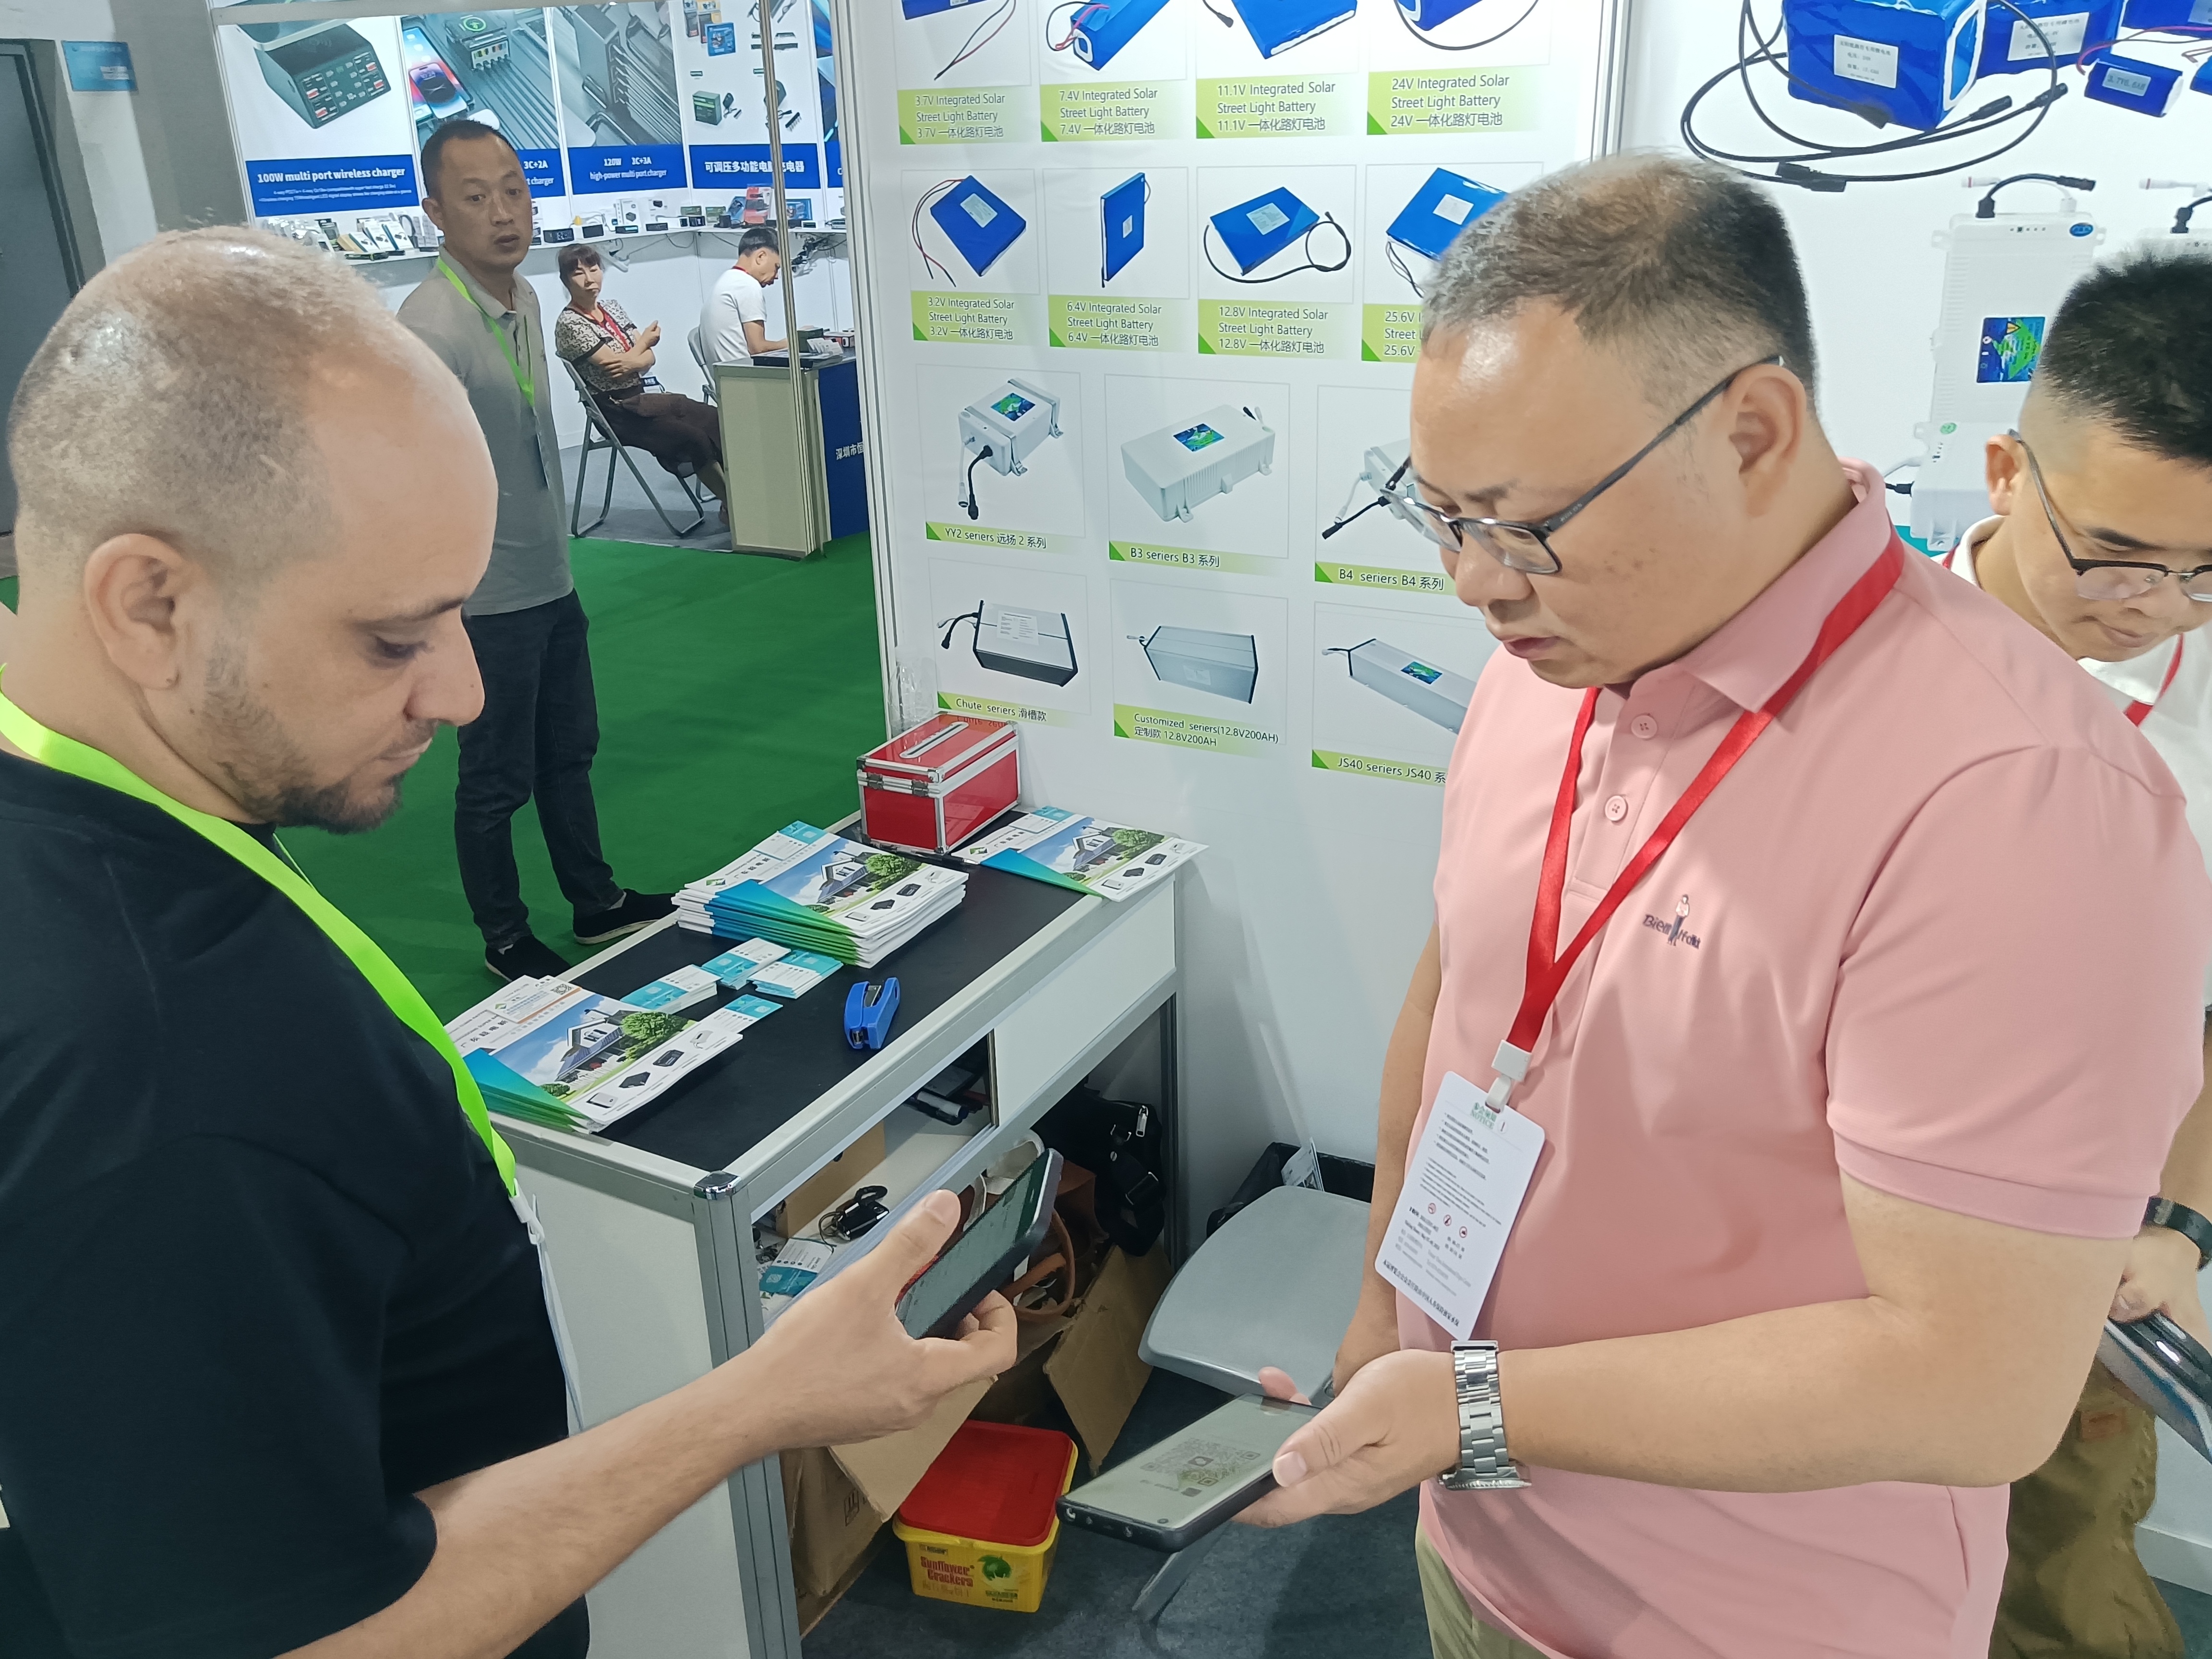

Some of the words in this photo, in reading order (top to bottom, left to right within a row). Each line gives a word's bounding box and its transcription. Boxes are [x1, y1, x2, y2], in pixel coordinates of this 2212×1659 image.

[1217, 84, 1246, 96] 11.1V
[1250, 82, 1304, 97] Integrated
[1309, 82, 1335, 93] Solar
[1392, 78, 1414, 90] 24V
[1418, 75, 1476, 91] Integrated
[1480, 74, 1510, 87] Solar
[915, 96, 934, 106] 3.7V
[937, 94, 980, 107] Integrated
[983, 94, 1006, 104] Solar
[1060, 91, 1079, 101] 7.4V
[1082, 88, 1130, 103] Integrated
[1134, 87, 1157, 99] Solar
[1391, 97, 1424, 108] Street
[1428, 96, 1455, 109] Light
[1459, 95, 1501, 108] Battery
[1060, 108, 1086, 118] Street
[1090, 107, 1112, 120] Light
[1116, 107, 1149, 118] Battery
[1217, 103, 1247, 113] Street
[1250, 102, 1275, 115] Light
[1278, 101, 1316, 114] Battery
[917, 112, 940, 122] Street
[944, 111, 964, 123] Light
[967, 110, 998, 122] Battery
[1391, 116, 1413, 127] 24V
[1416, 112, 1503, 127] 一体化路灯电池
[1060, 124, 1081, 135] 7.4V
[1083, 122, 1155, 135] 一体化路灯电池
[1217, 120, 1246, 131] 11.1V
[1248, 118, 1325, 131] 一体化路灯电池
[918, 128, 936, 138] 3.7V
[938, 126, 1003, 138] 一体化路灯电池
[258, 172, 283, 183] 100W
[285, 171, 311, 181] multi
[312, 170, 332, 182] port
[333, 168, 371, 179] wireless
[372, 168, 405, 179] charger
[928, 297, 946, 306] 3.2V
[949, 298, 990, 310] Integrated
[993, 300, 1014, 309] Solar
[1067, 302, 1086, 311] 6.4V
[1089, 302, 1135, 314] Integrated
[1139, 304, 1161, 313] Solar
[929, 312, 952, 321] Street
[955, 313, 975, 324] Light
[978, 313, 1007, 326] Battery
[1219, 307, 1245, 317] 12.8V
[1249, 308, 1299, 320] Integrated
[1303, 309, 1328, 320] Solar
[1385, 312, 1415, 322] 25.6V
[1068, 317, 1093, 326] Street
[1096, 318, 1118, 330] Light
[1121, 319, 1153, 332] Battery
[1219, 323, 1246, 333] Street
[1250, 324, 1274, 337] Light
[1277, 325, 1312, 338] Battery
[930, 327, 948, 335] 3.2V
[950, 327, 1013, 339] 一体化路灯电池
[1069, 333, 1087, 342] 6.4V
[1090, 333, 1158, 346] 一体化路灯电池
[1385, 328, 1415, 339] Street
[1219, 339, 1246, 349] 12.8V
[1249, 339, 1324, 353] 一体化路灯电池
[1384, 345, 1415, 355] 25.6V
[945, 528, 962, 538] YY2
[965, 531, 994, 541] seriers
[997, 533, 1016, 545] 远扬
[1019, 536, 1024, 545] 2
[1027, 537, 1046, 548] 系列
[1131, 548, 1142, 557] B3
[1146, 550, 1178, 562] seriers
[1183, 553, 1194, 563] B3
[1199, 554, 1219, 567] 系列
[1340, 569, 1353, 579] B4
[1360, 572, 1397, 584] seriers
[1402, 576, 1416, 586] B4
[1419, 577, 1443, 590] 系列
[956, 698, 982, 710] Chute
[987, 705, 1015, 716] seriers
[1018, 708, 1046, 721] 滑槽款
[1134, 713, 1184, 728] Customized
[1134, 726, 1161, 739] 定制款
[1165, 731, 1217, 746] 12.8V200AH
[1338, 757, 1363, 769] JS40
[1367, 763, 1402, 776] seriers
[1406, 768, 1431, 780] JS40
[1434, 771, 1448, 783] 系
[928, 1570, 973, 1587] Crackers
